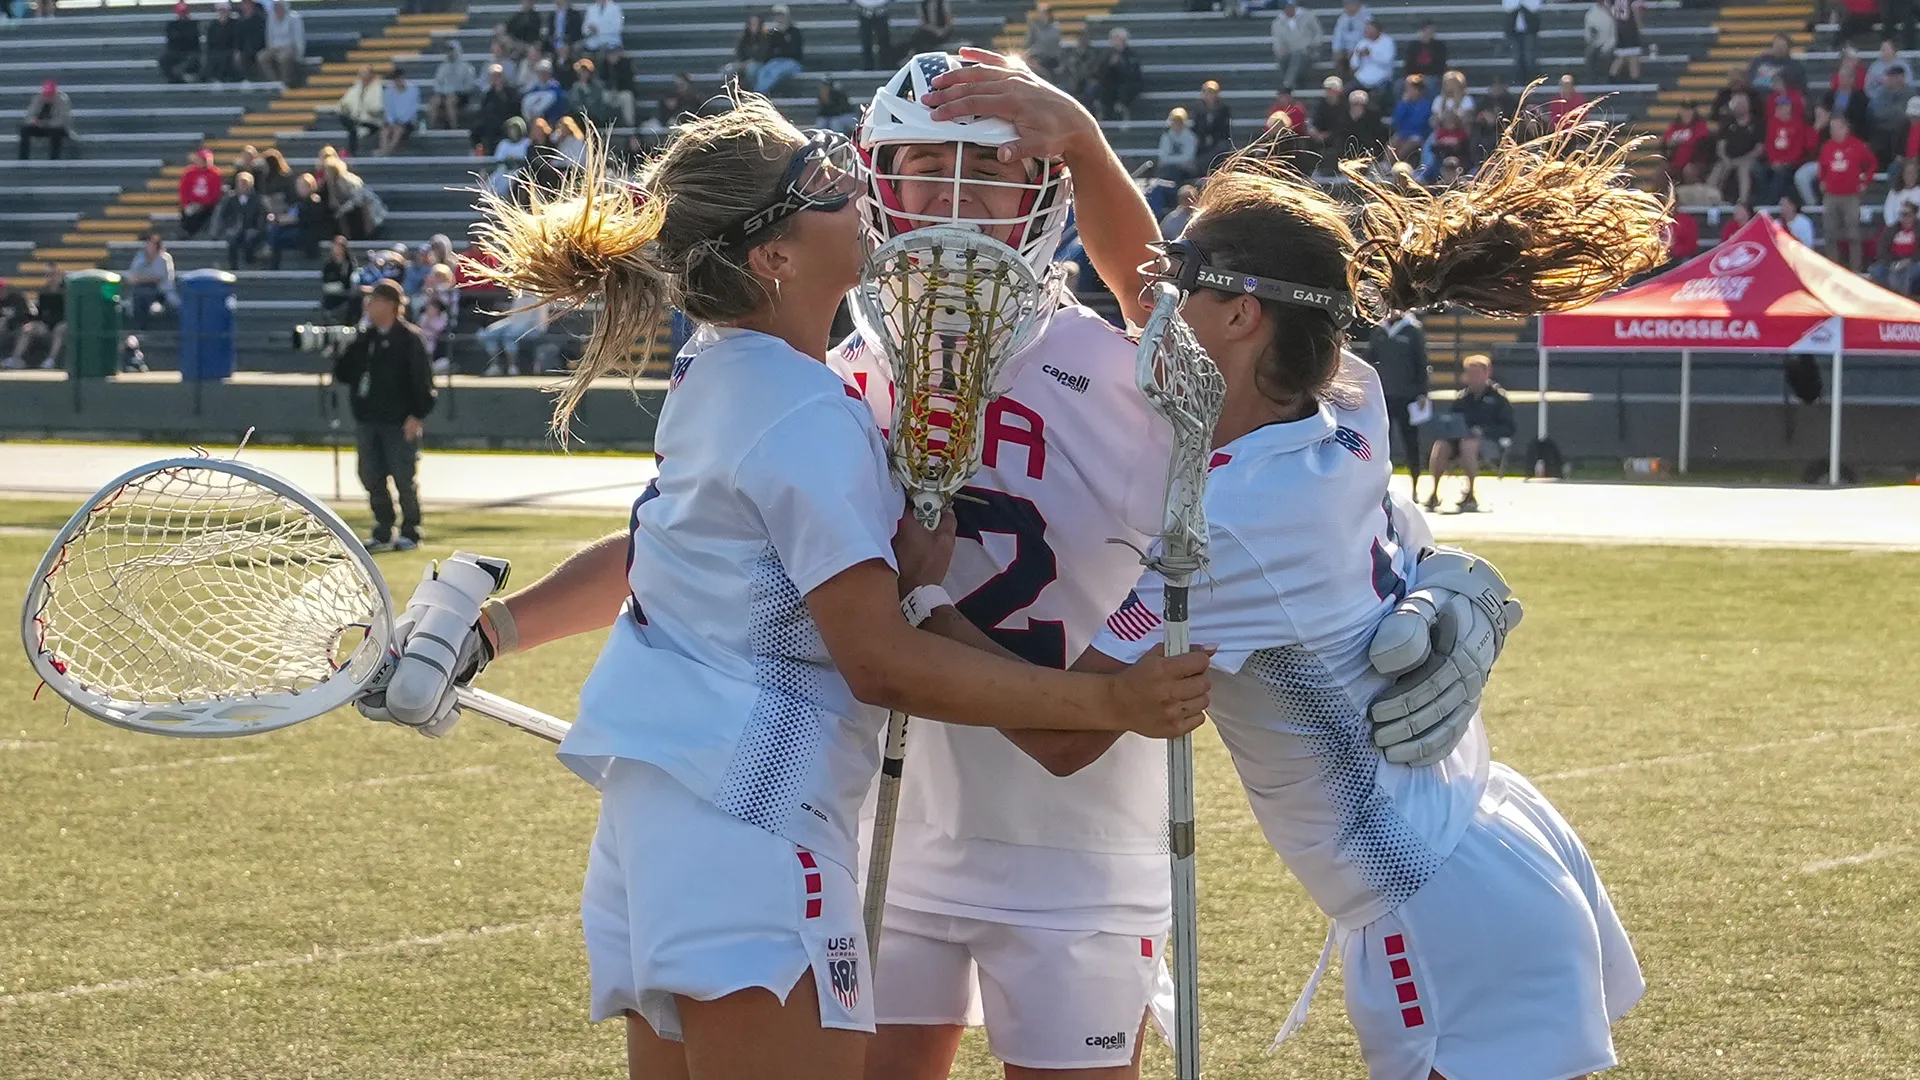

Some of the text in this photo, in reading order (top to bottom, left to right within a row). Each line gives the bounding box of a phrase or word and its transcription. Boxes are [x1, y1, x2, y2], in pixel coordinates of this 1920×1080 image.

[743, 195, 798, 236] STX
[1293, 289, 1332, 306] GAIT
[1614, 319, 1761, 340] LACROSSE.CA
[1042, 363, 1091, 391] capelli
[1061, 380, 1087, 395] SPORT
[371, 662, 390, 684] STX
[828, 938, 856, 950] USA
[1085, 1032, 1125, 1048] capelli
